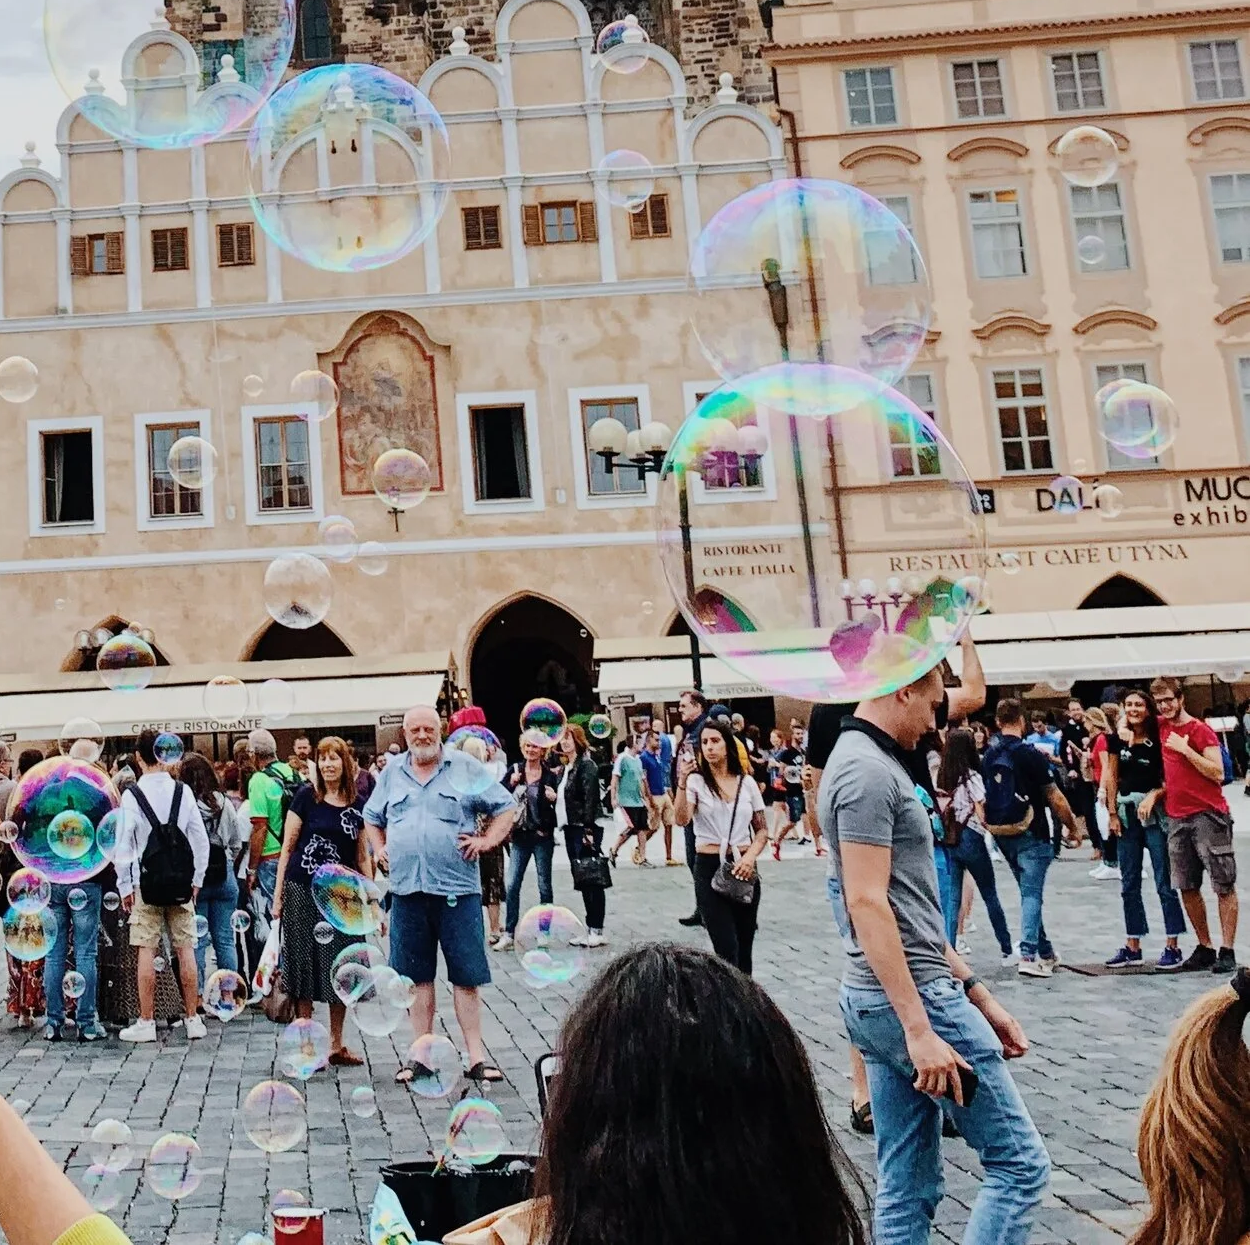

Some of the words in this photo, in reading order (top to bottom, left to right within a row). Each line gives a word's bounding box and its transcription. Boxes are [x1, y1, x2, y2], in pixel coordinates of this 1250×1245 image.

[1173, 505, 1248, 526] exhib
[703, 543, 784, 557] RISTORANTE
[888, 550, 1036, 572] RESTAURANT
[1045, 542, 1100, 567] CAFÉ
[1107, 546, 1122, 563] U
[751, 564, 795, 575] ITALIA
